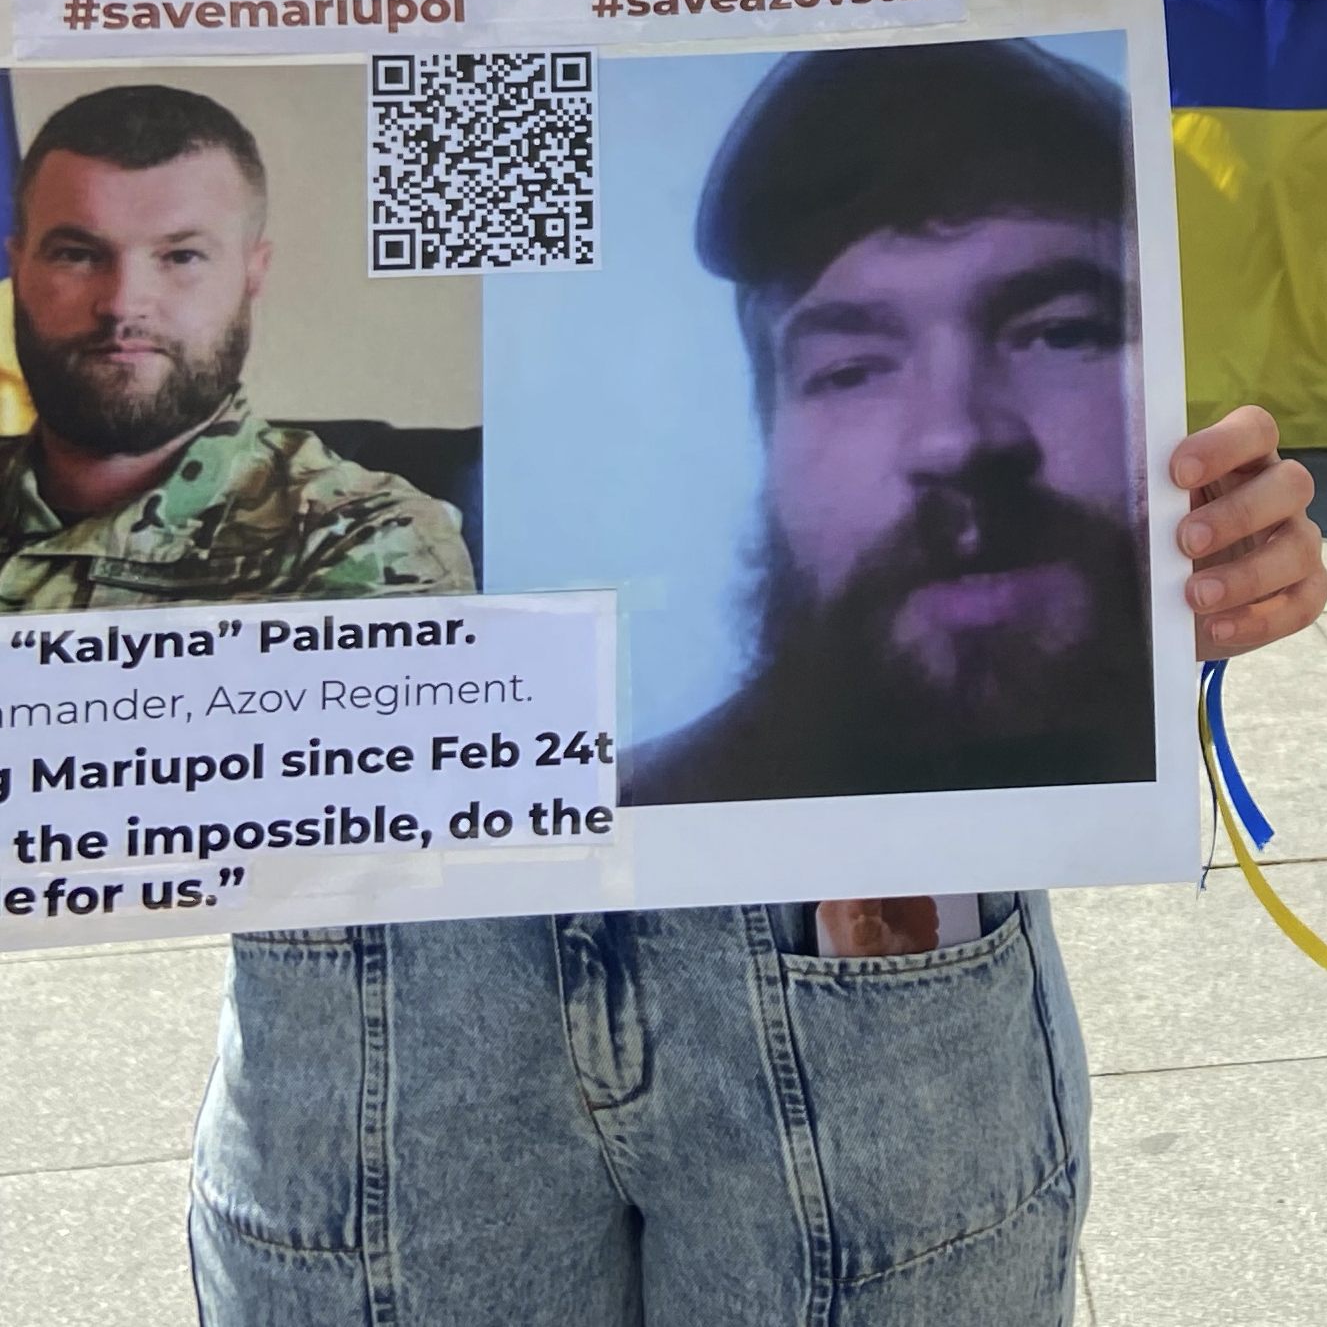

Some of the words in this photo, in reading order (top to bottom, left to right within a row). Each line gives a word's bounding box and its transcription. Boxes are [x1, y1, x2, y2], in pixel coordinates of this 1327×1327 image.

[10, 618, 243, 669] “Kalyna”
[259, 616, 477, 654] Palamar.
[0, 687, 193, 728] mander,
[206, 685, 307, 717] Azov
[321, 674, 534, 716] Regiment.
[31, 743, 265, 793] Mariupol
[281, 737, 415, 779] since
[432, 732, 521, 771] Feb
[14, 824, 108, 864] the
[126, 804, 433, 860] impossible,
[449, 800, 514, 840] do
[529, 797, 614, 836] the
[142, 866, 246, 910] us.”
